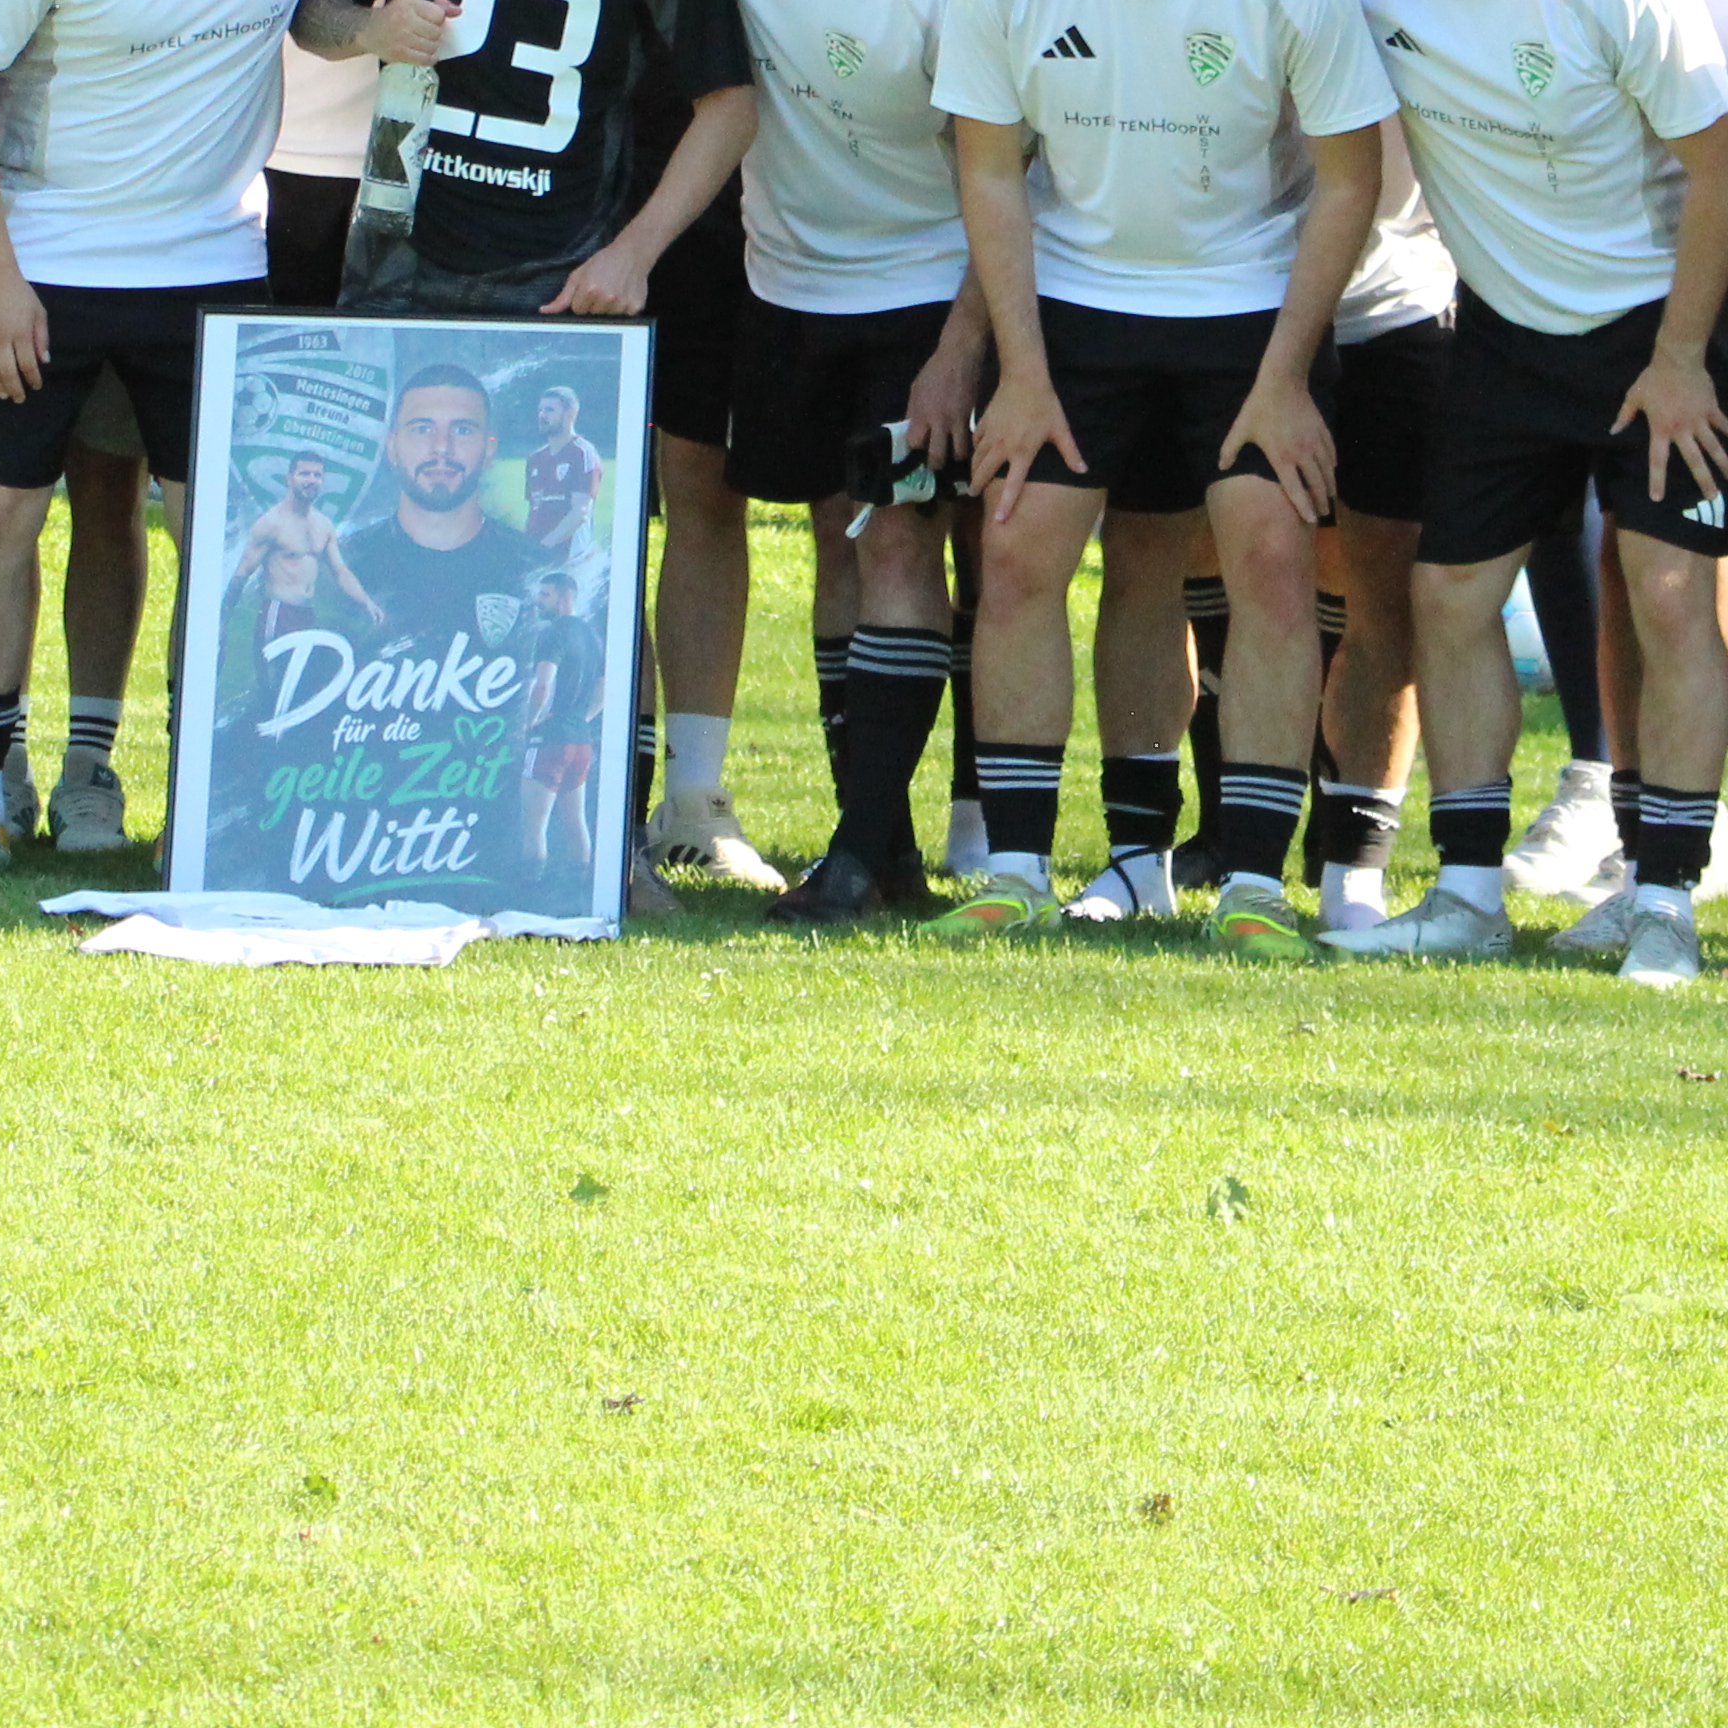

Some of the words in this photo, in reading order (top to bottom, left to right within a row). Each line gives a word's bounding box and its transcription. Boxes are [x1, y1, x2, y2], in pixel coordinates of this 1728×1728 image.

[1064, 111, 1113, 127] HOTE
[422, 146, 551, 197] ittkowskji
[298, 335, 329, 350] 1963
[344, 363, 377, 384] 2010
[306, 401, 351, 424] Breuna
[282, 419, 366, 454] Oberlistingen
[256, 628, 523, 745] Danke
[332, 714, 377, 753] für
[382, 713, 423, 742] die
[258, 745, 385, 831] geile
[388, 740, 515, 807] Zeit
[289, 806, 481, 885] Witti
